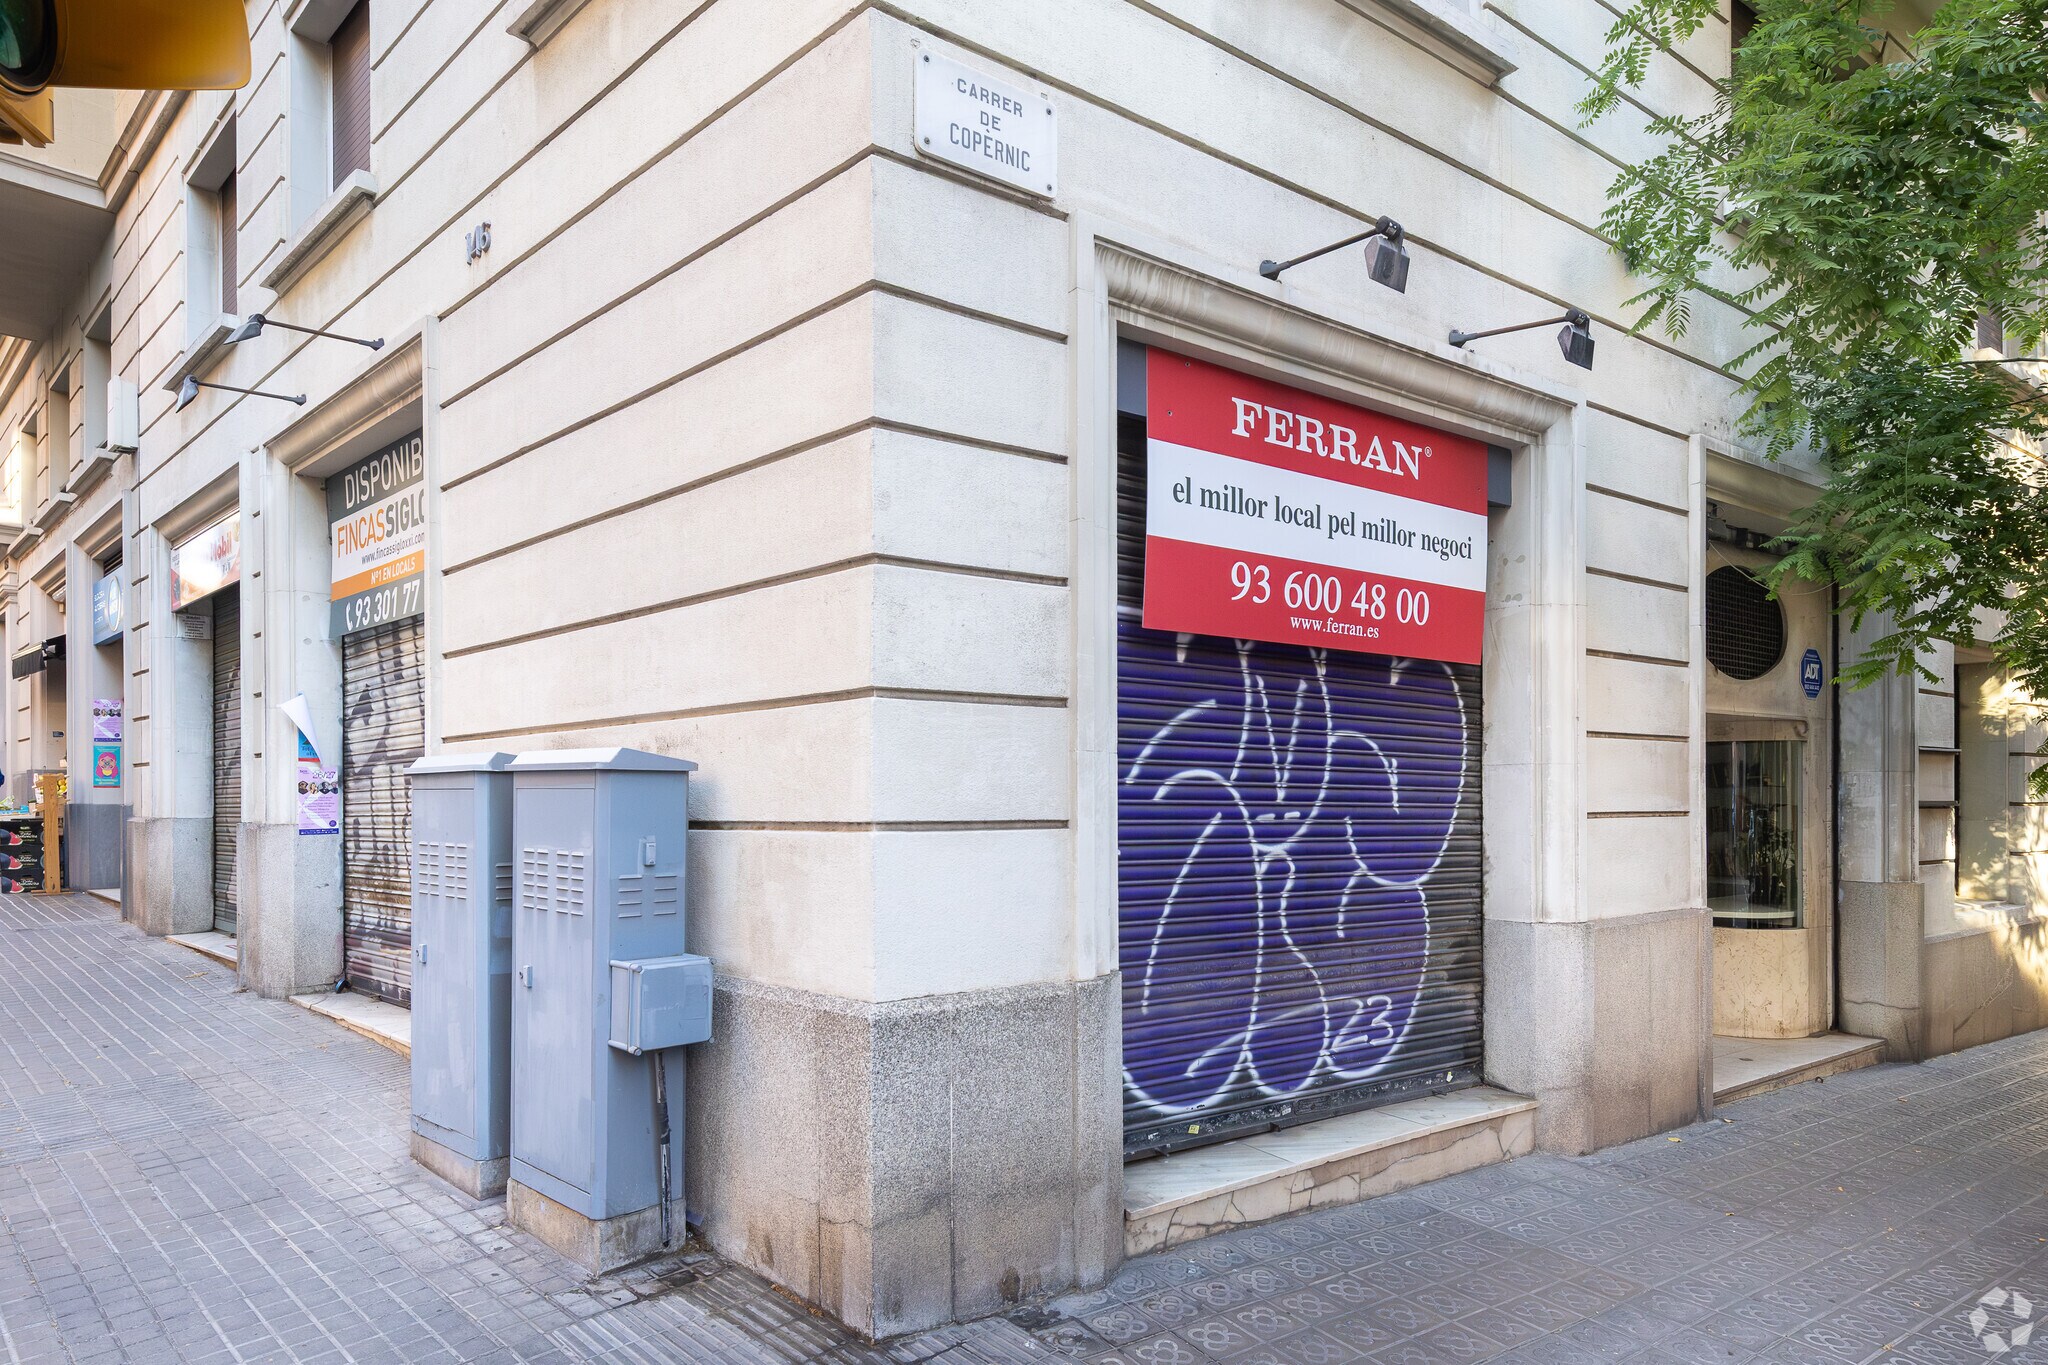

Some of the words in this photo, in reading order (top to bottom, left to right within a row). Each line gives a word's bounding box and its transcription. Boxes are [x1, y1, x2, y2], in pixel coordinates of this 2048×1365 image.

[957, 78, 1023, 118] CARRER
[980, 111, 1001, 132] DE
[950, 122, 1031, 172] COPÈRNIC
[1172, 476, 1192, 505] el
[1199, 484, 1268, 519] millor
[1274, 495, 1321, 530] local
[1328, 511, 1355, 539] pel
[1361, 517, 1416, 548] millor
[1421, 536, 1473, 562] negoci
[382, 565, 392, 582] EN
[392, 556, 416, 577] LOCALS
[355, 596, 371, 628] 93
[374, 586, 398, 624] 301
[403, 578, 421, 617] 77
[1230, 561, 1271, 605] 93
[1284, 570, 1342, 614] 600
[1351, 581, 1386, 620] 48
[1396, 588, 1430, 626] 00
[1290, 615, 1380, 640] www.ferran.es
[1804, 663, 1820, 680] ADT
[1331, 995, 1394, 1054] 23
